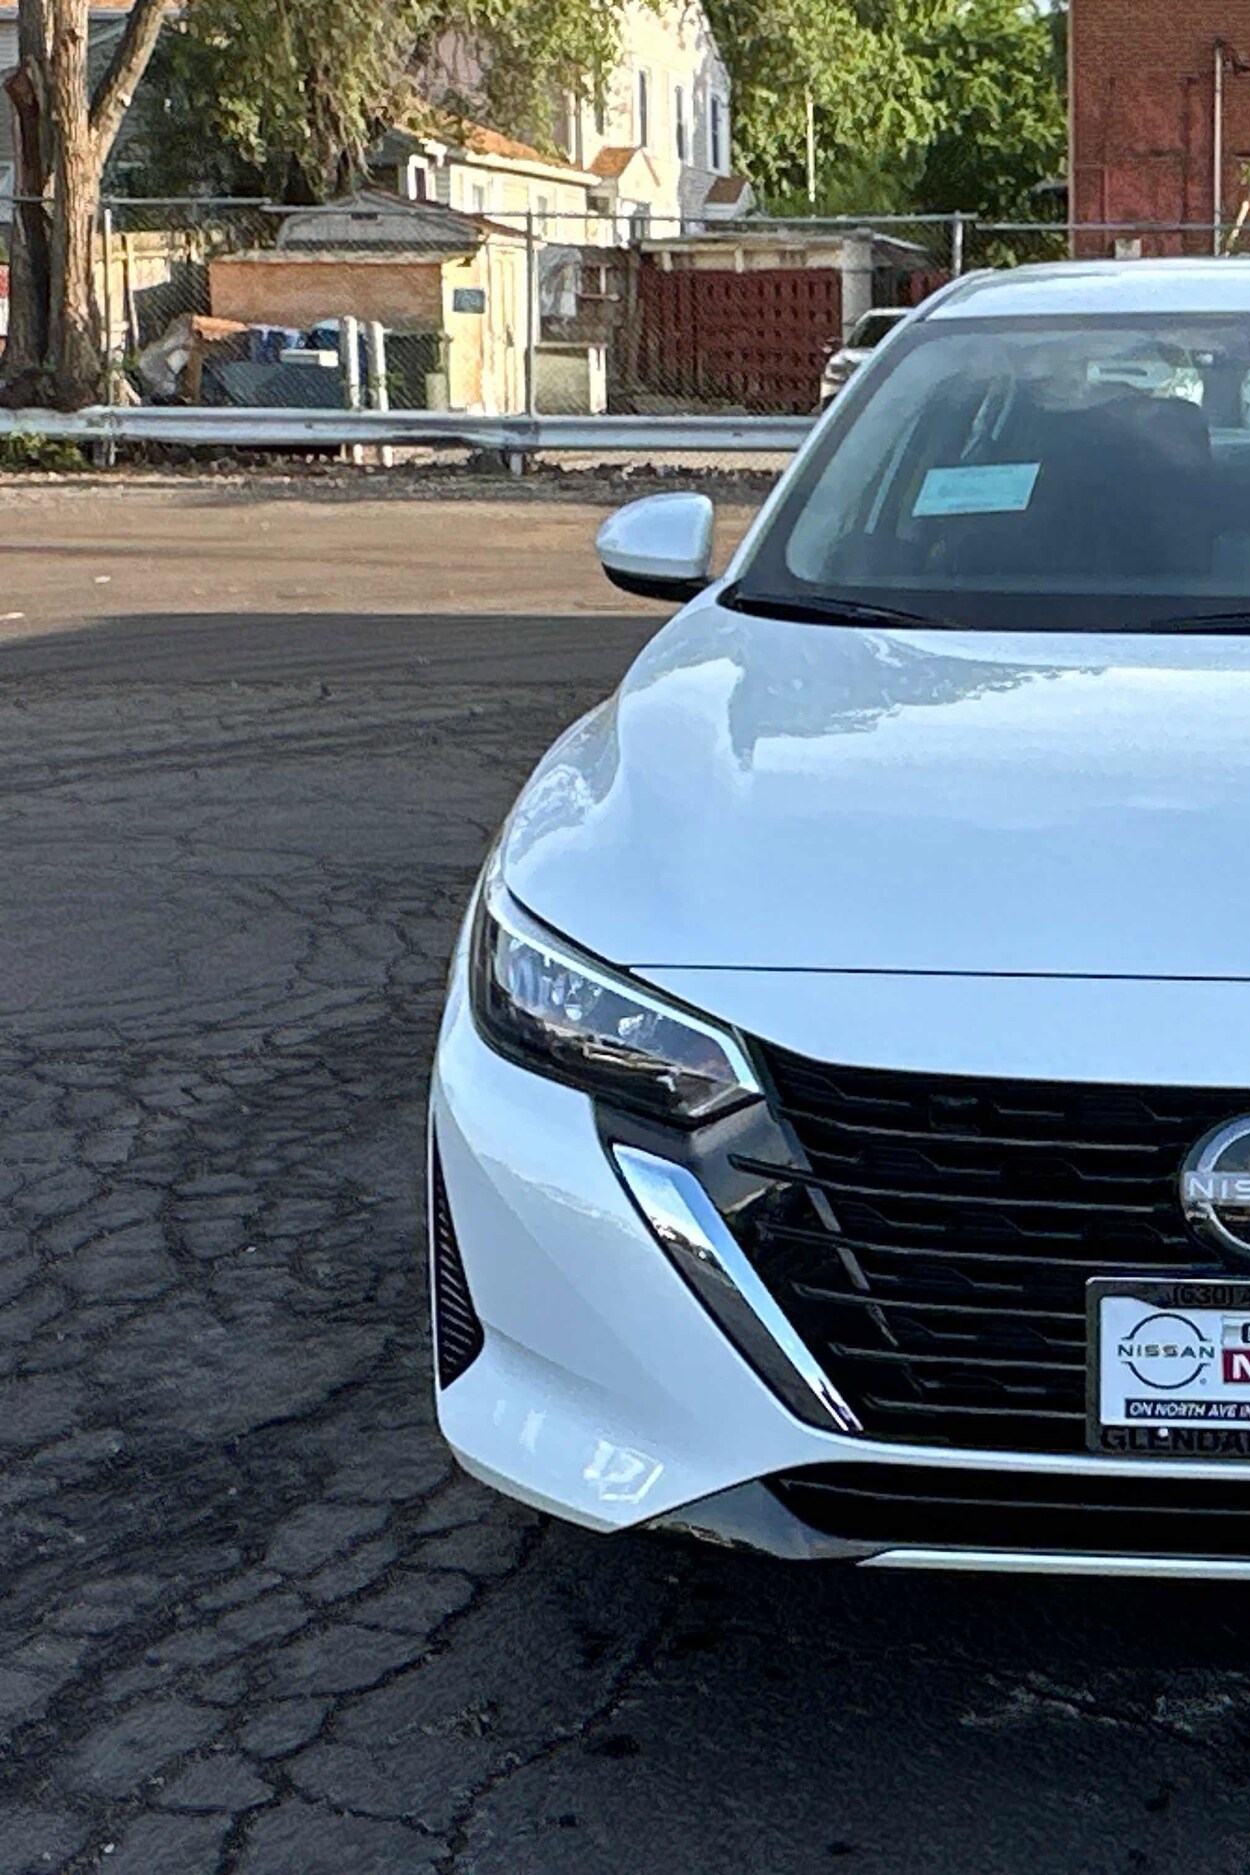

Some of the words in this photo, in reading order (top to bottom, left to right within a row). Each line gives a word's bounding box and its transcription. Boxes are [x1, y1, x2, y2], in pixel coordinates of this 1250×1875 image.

[1117, 1344, 1215, 1359] NISSAN
[1130, 1402, 1153, 1416] ON
[1155, 1402, 1206, 1417] NORTH
[1208, 1404, 1237, 1418] AVE
